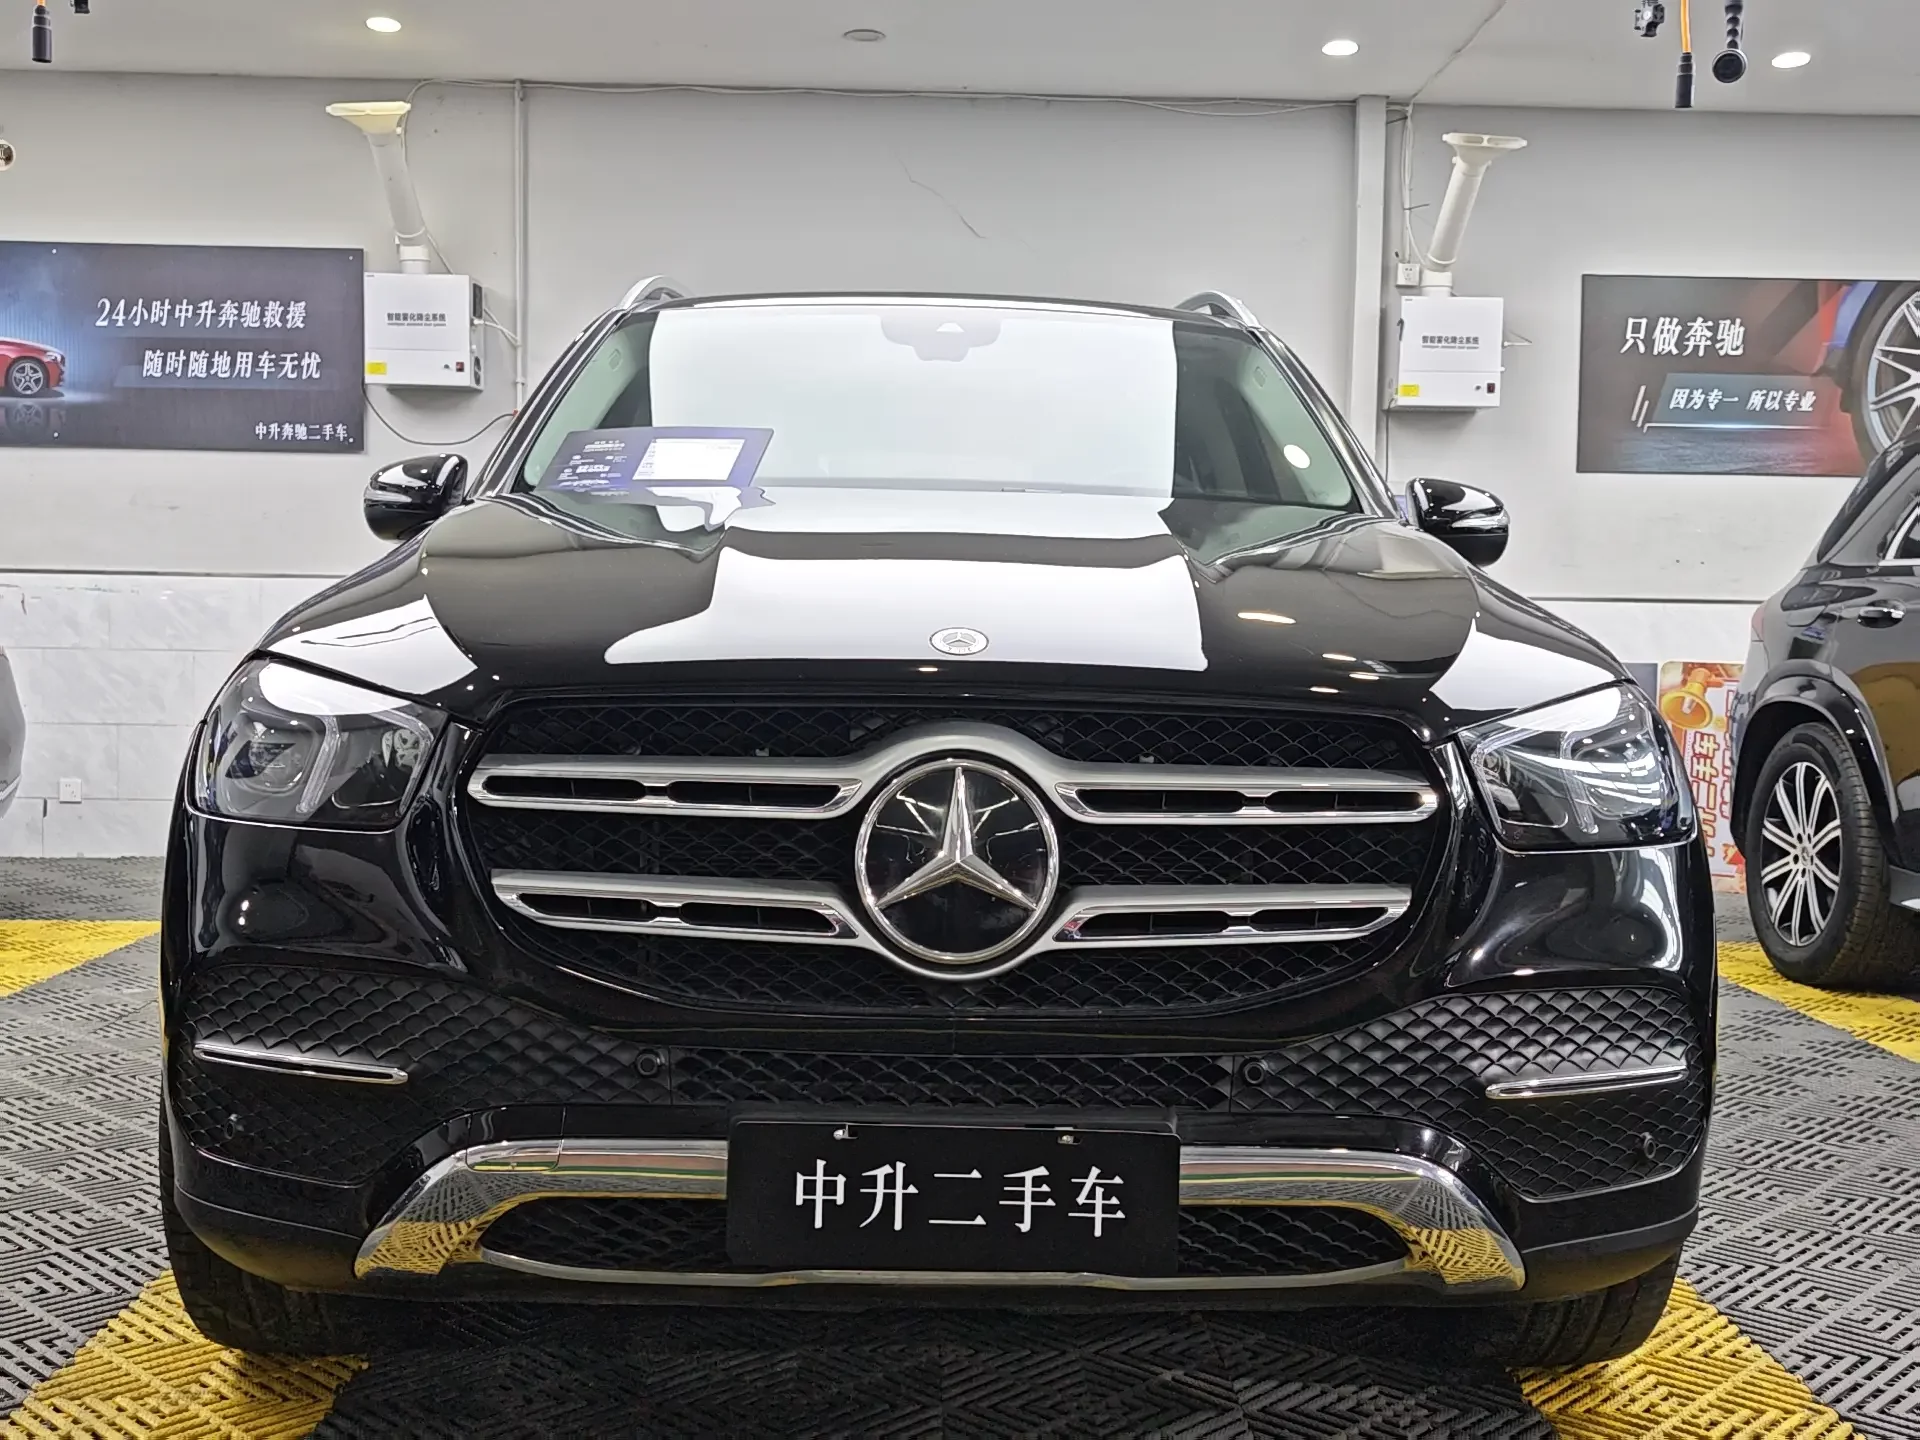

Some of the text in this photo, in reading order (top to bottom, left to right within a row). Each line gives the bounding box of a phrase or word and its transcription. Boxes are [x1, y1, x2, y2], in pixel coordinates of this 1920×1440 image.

[95, 297, 307, 329] 24小时中升奔驰救援
[387, 312, 447, 322] 智能雾化降尘系统
[1619, 315, 1746, 358] 只做奔驰
[142, 349, 322, 381] 随时随地用车无忧
[1668, 387, 1818, 412] 因为专一 所以专业
[254, 421, 348, 442] 中升奔驰二手车
[795, 1158, 1127, 1238] 中升二手车
